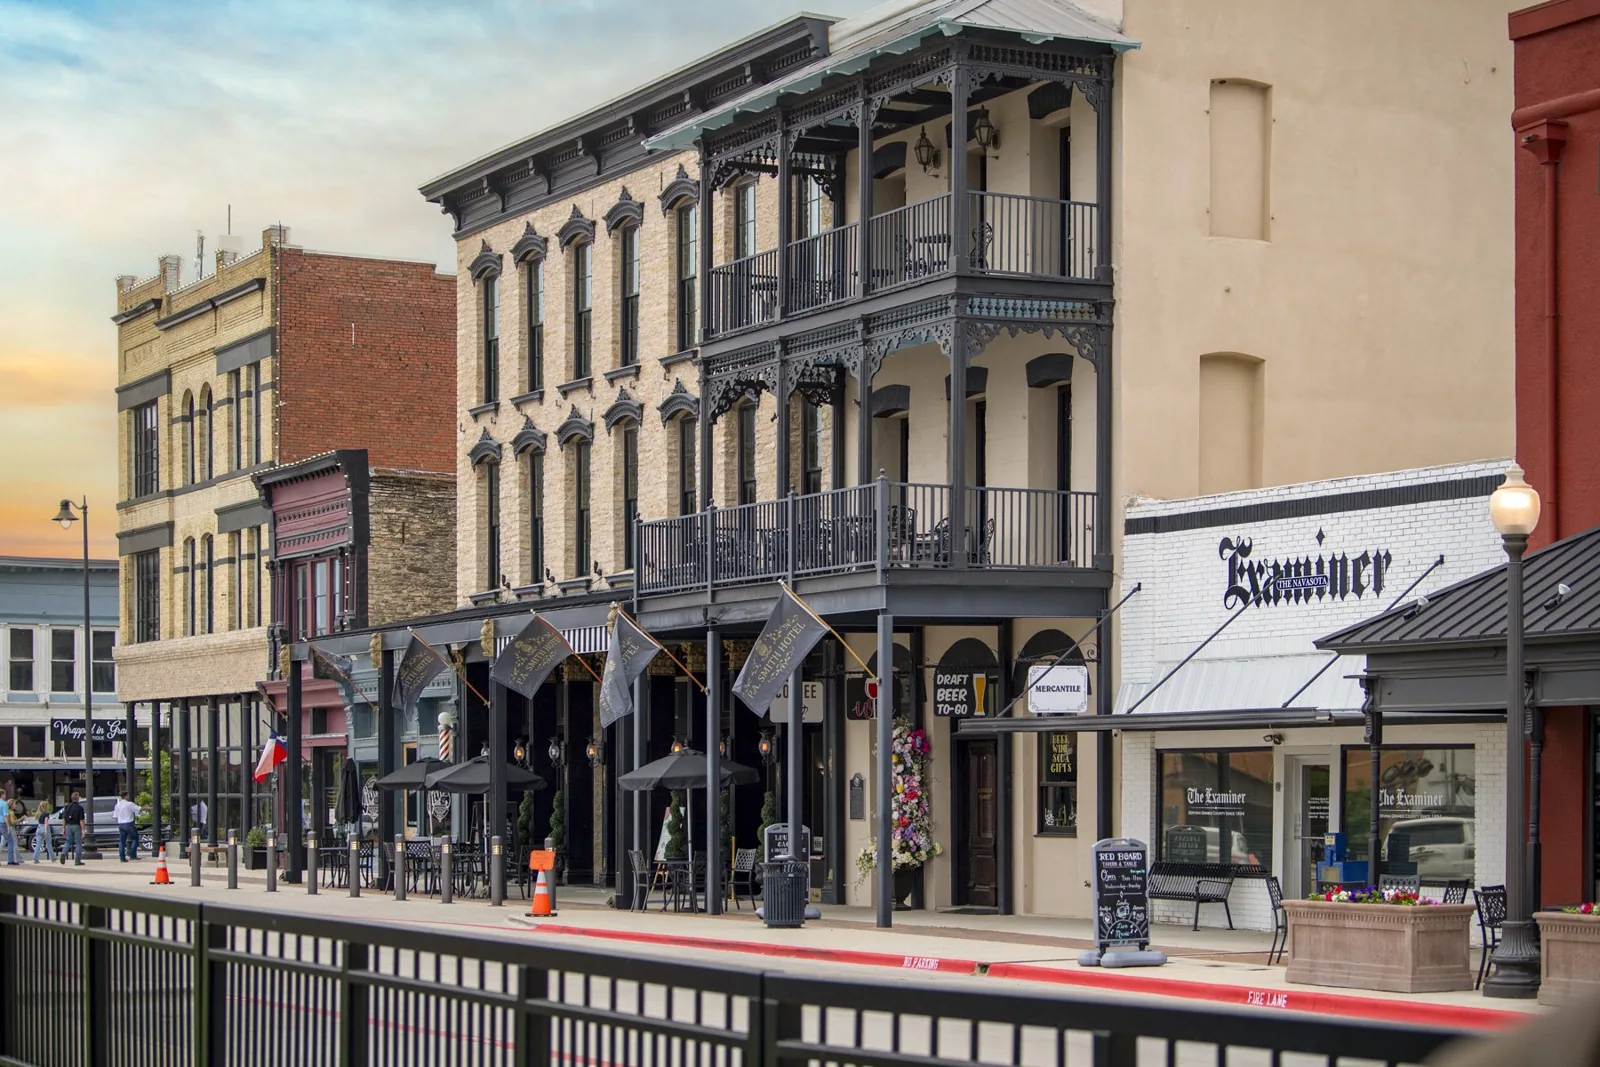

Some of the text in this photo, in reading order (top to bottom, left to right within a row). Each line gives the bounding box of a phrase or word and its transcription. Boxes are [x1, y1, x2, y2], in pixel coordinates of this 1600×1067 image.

[1219, 526, 1392, 610] Examiner
[1278, 576, 1327, 588] THE NAVASOTA
[526, 648, 548, 672] SMITH
[621, 643, 640, 664] OTEL
[747, 623, 806, 699] P.A. SMITH HOTEL
[937, 674, 969, 685] DRAFT
[776, 684, 816, 698] COEE
[937, 688, 967, 702] BEER
[1035, 684, 1081, 693] MERCANTILE
[937, 704, 968, 715] TO-GO
[54, 719, 96, 739] Wrappd
[96, 726, 105, 734] in
[1053, 754, 1069, 762] SODA
[1050, 763, 1071, 773] GIFTS
[1187, 787, 1246, 805] The Examiner
[1396, 788, 1443, 808] Examiner
[1099, 852, 1142, 860] RED BOARD
[1101, 869, 1116, 881] Open
[903, 957, 939, 970] NO PARKING
[1247, 991, 1287, 1008] FIRE LANE
